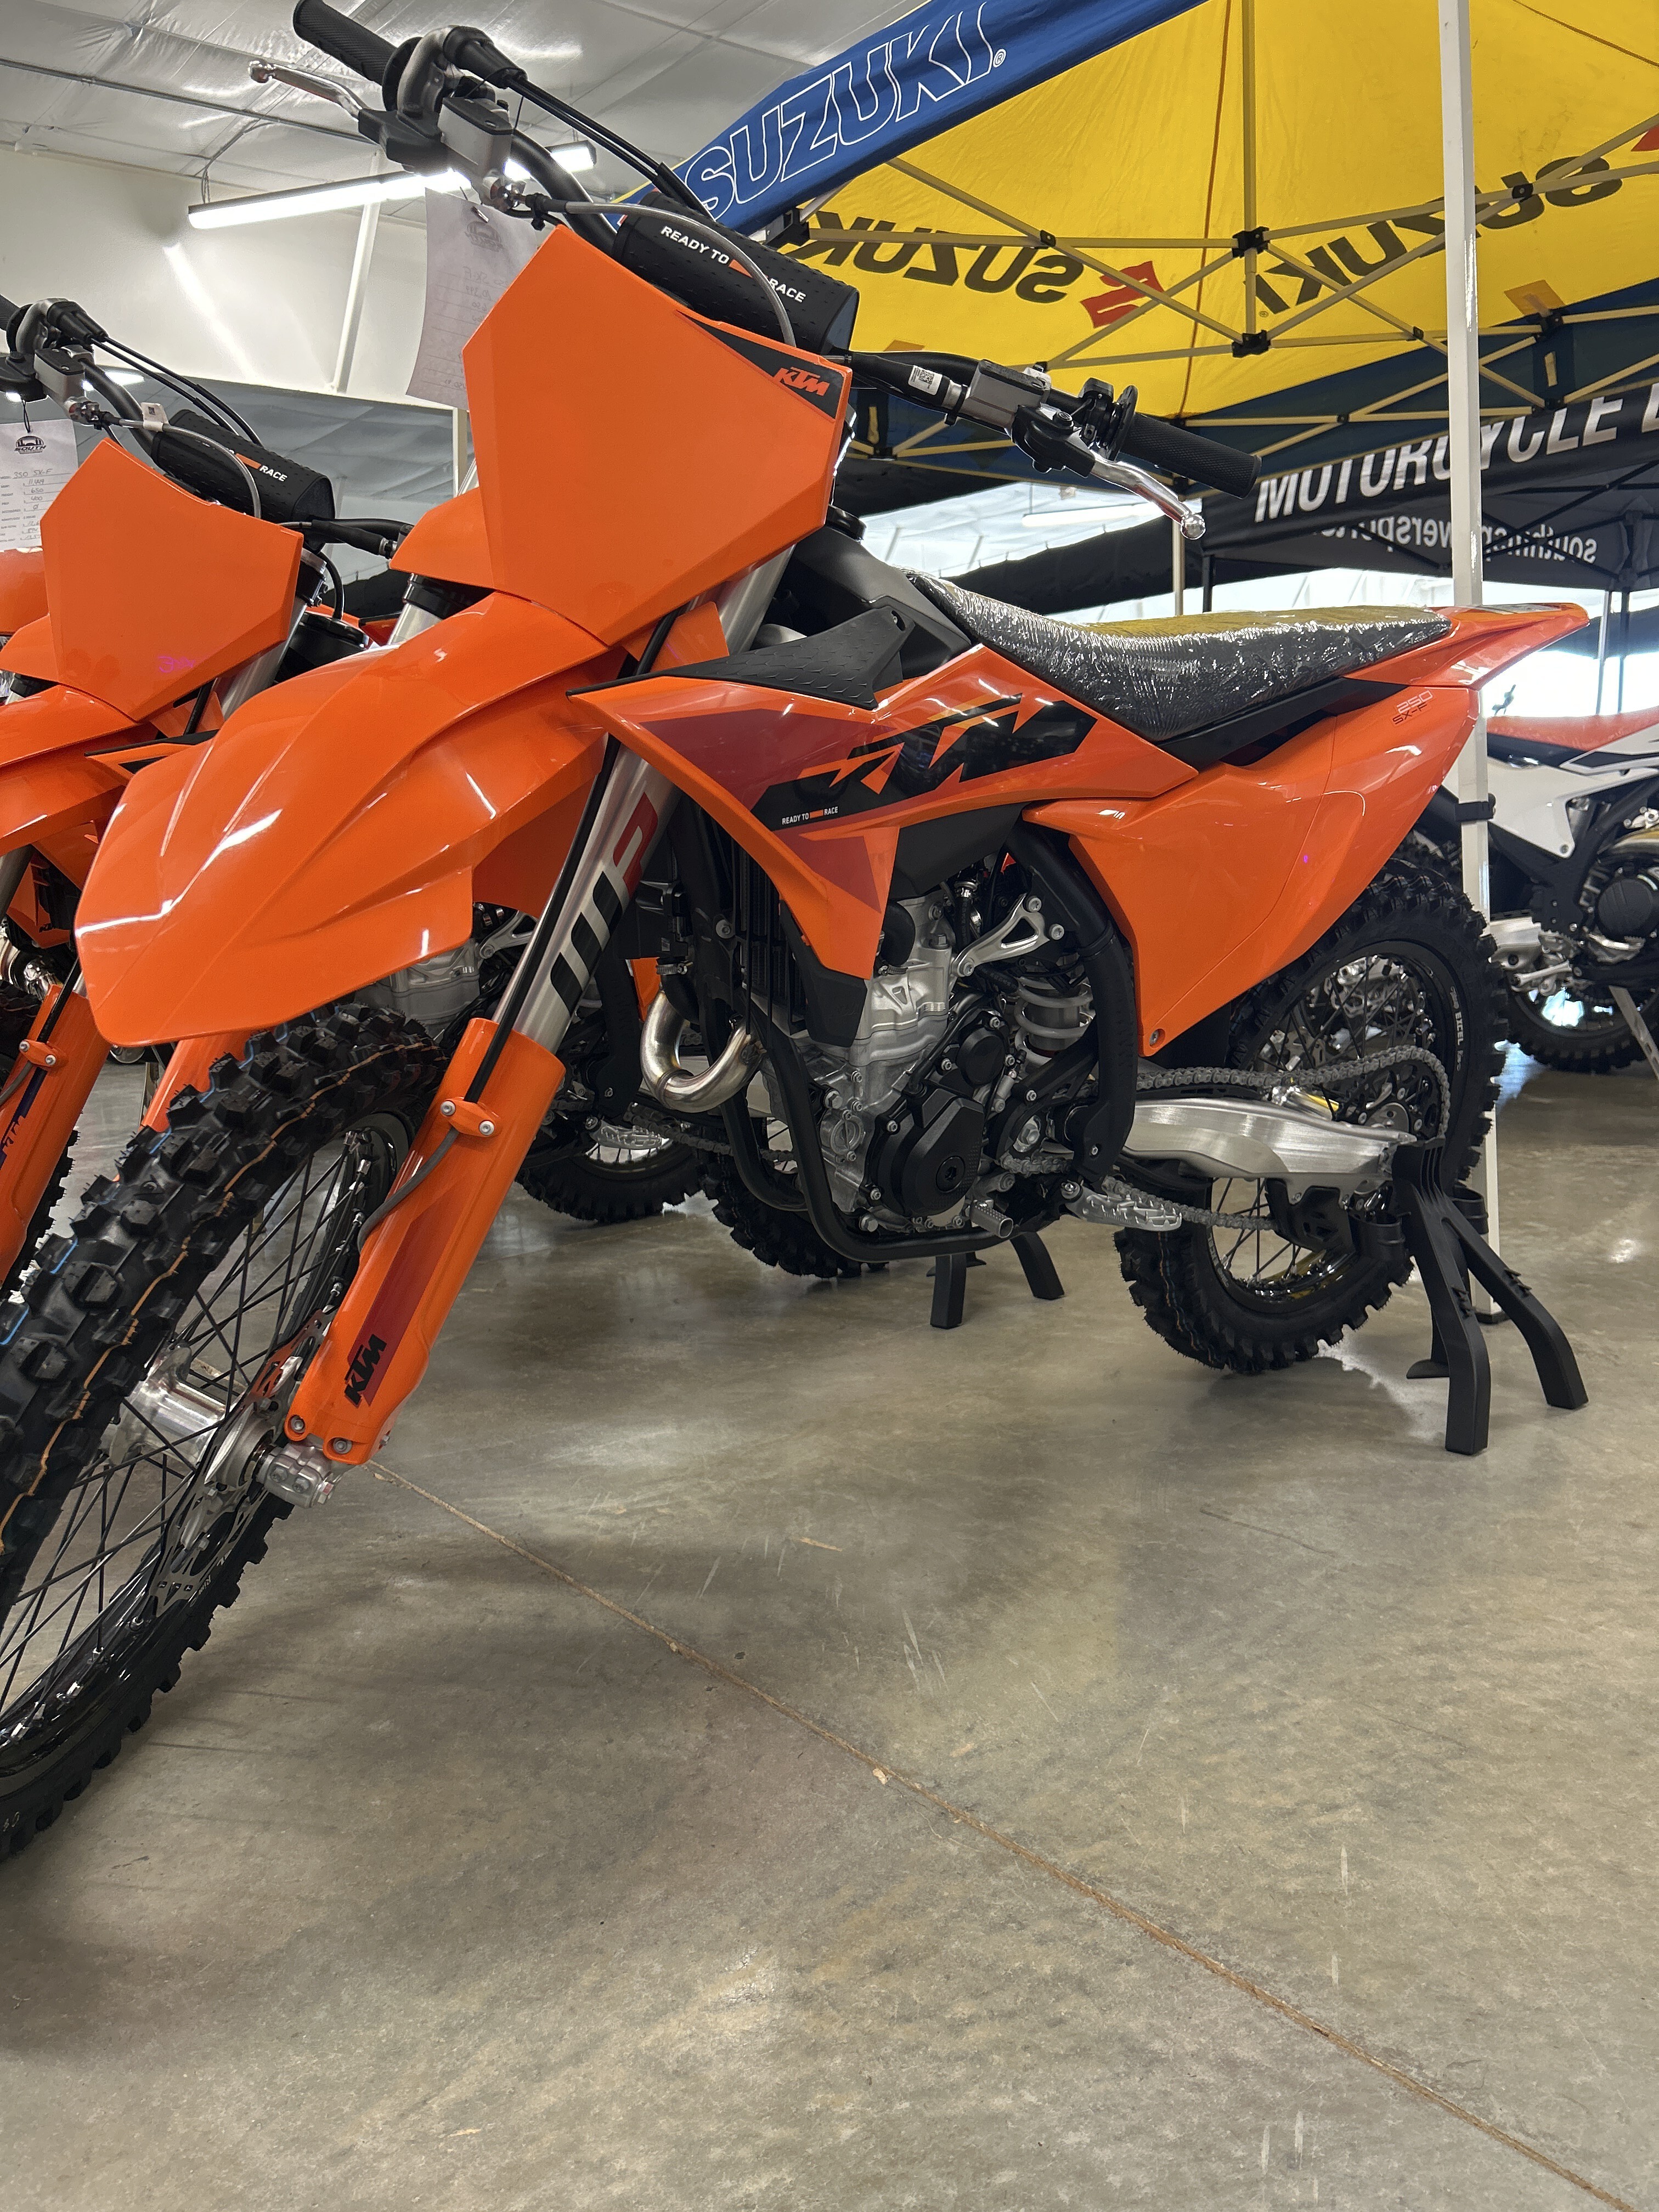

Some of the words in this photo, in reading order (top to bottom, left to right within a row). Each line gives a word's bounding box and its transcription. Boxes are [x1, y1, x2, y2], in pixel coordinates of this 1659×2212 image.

[661, 225, 710, 255] READY
[710, 249, 730, 265] TO
[769, 278, 806, 303] RACE
[772, 366, 830, 396] KTM
[259, 465, 288, 482] RACE
[1392, 702, 1427, 725] SX-F
[1396, 690, 1433, 714] 250
[782, 814, 801, 825] READY
[802, 812, 809, 821] TO
[824, 806, 838, 816] RACE
[1455, 1012, 1464, 1046] EXCEL
[345, 1334, 387, 1405] KTM
